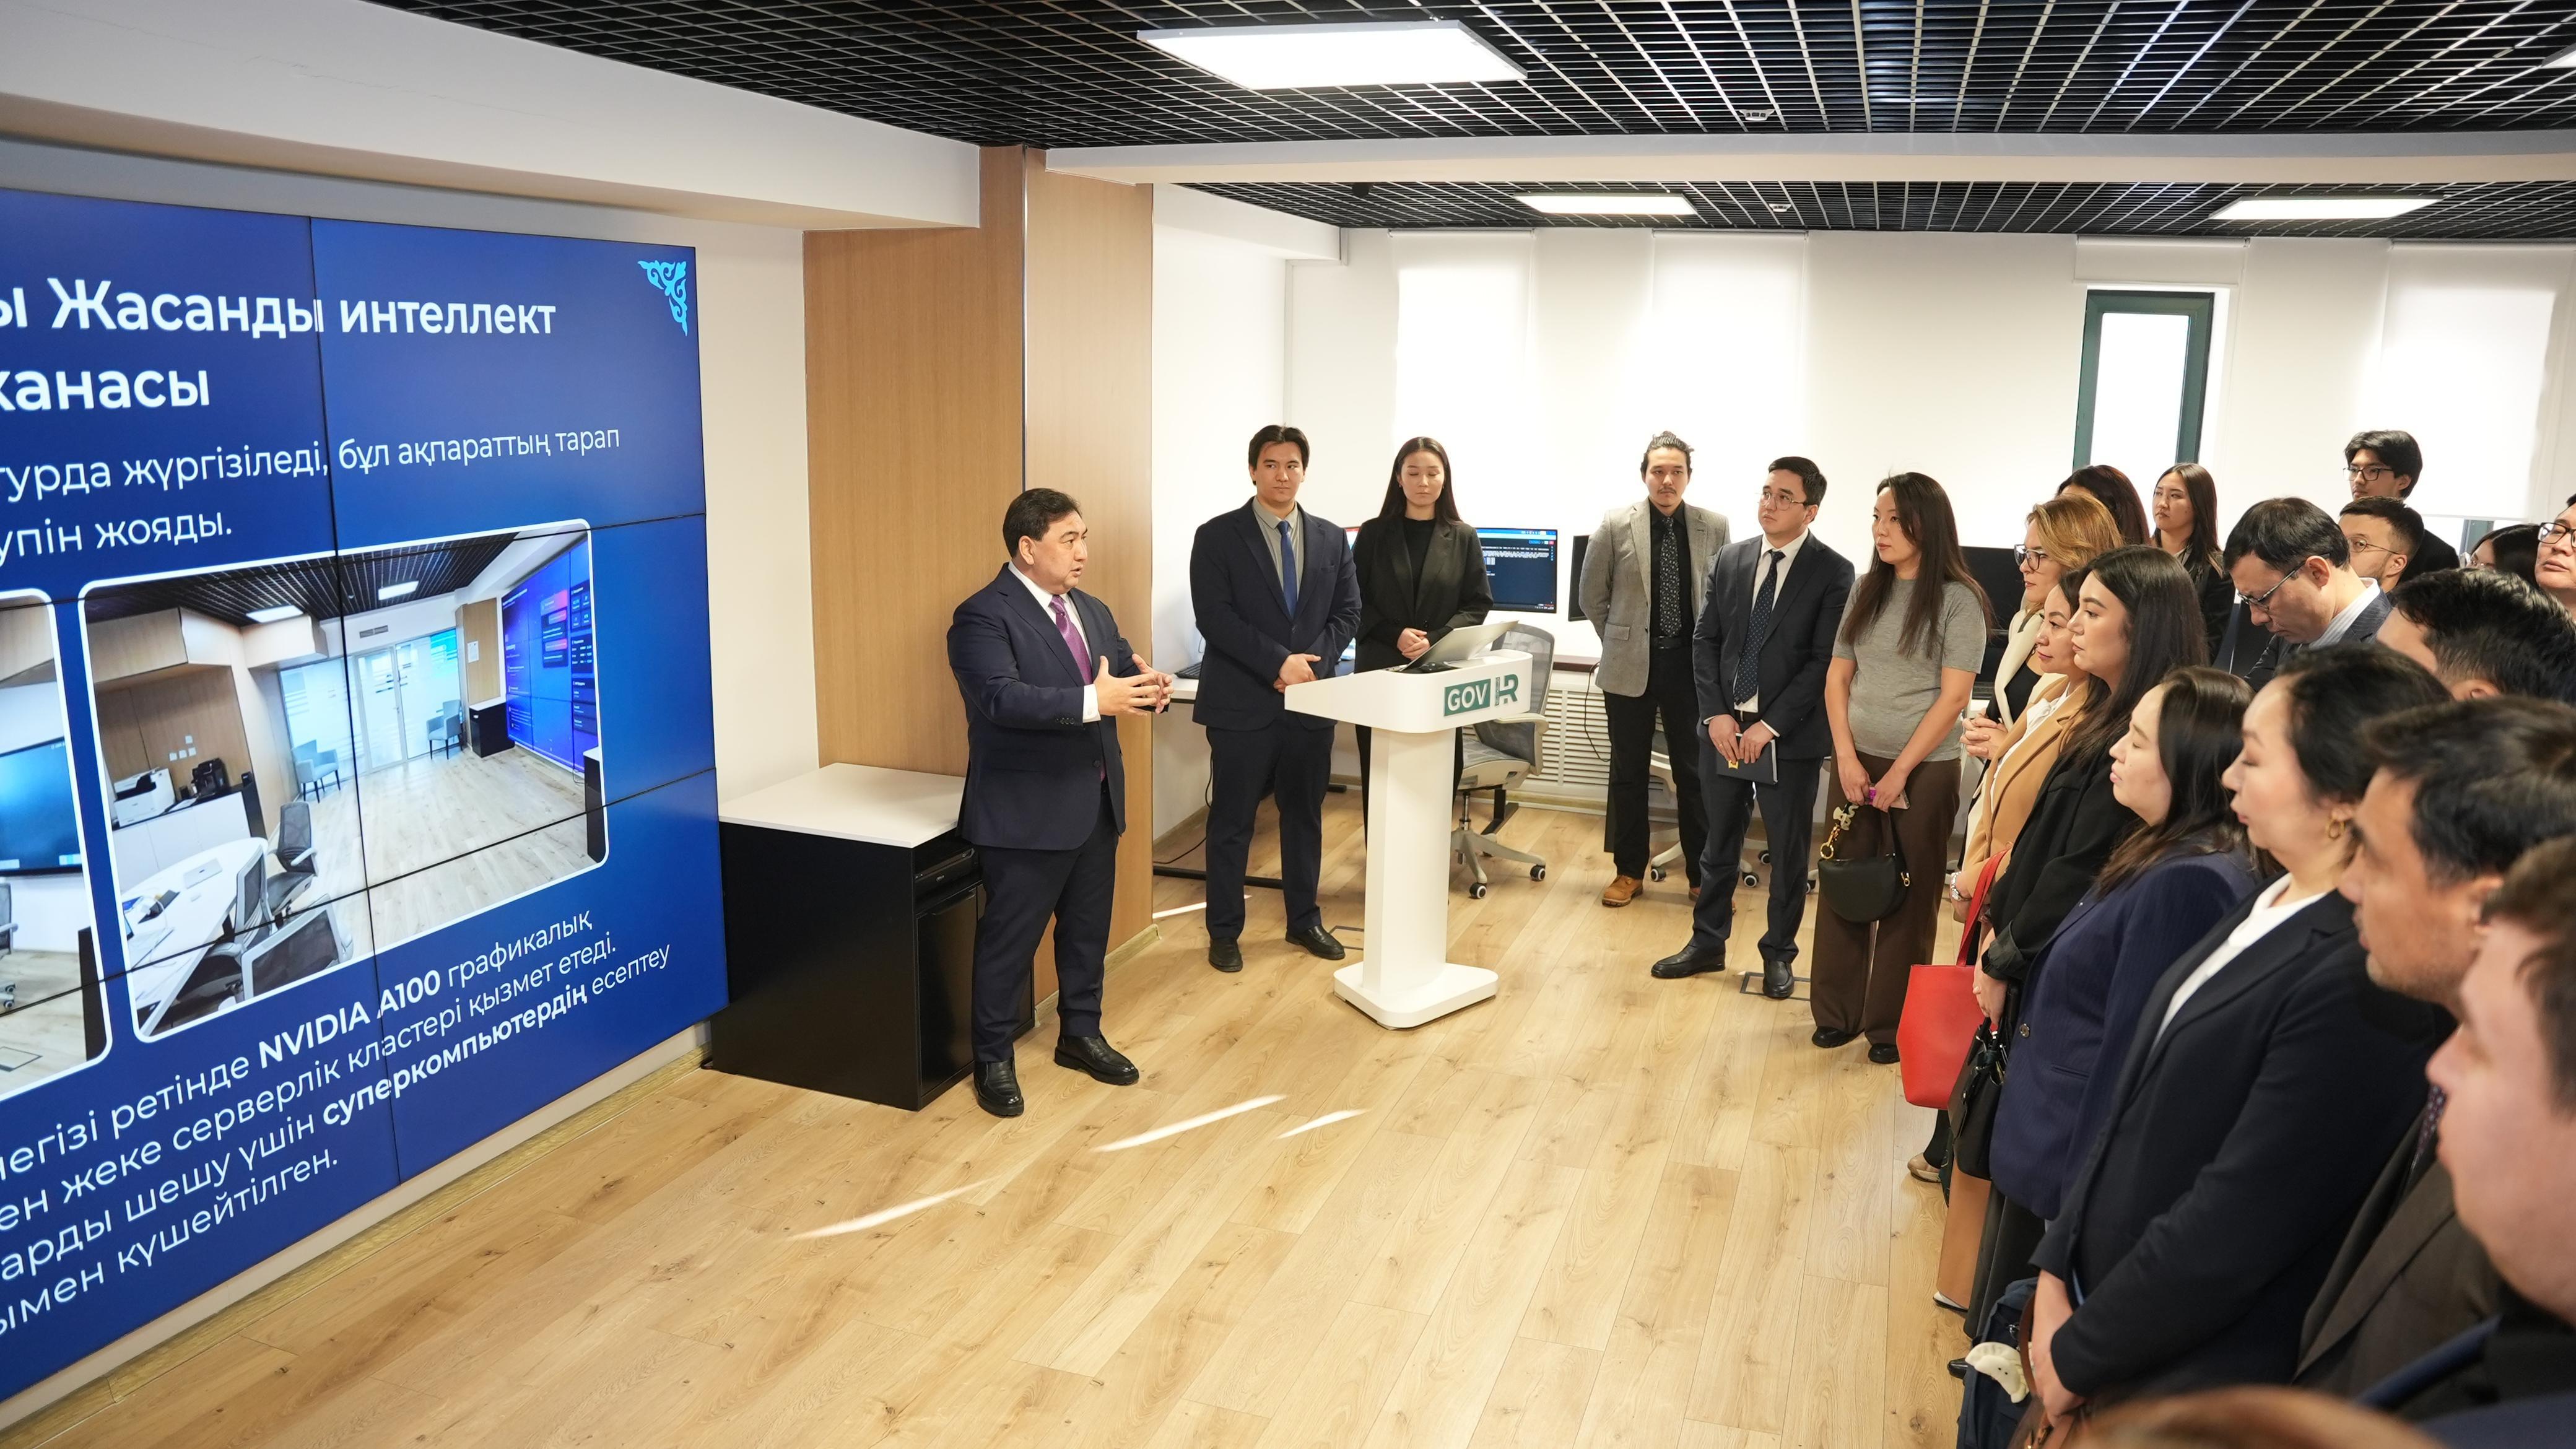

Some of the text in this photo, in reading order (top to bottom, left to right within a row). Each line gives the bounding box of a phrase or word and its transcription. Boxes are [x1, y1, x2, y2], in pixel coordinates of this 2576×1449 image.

[47, 277, 324, 339] Жасанды
[340, 300, 556, 334] интеллект
[123, 440, 328, 491] жүргізіледі,
[339, 438, 389, 474] бұл
[398, 433, 551, 466] ақпараттың
[554, 429, 620, 456] тарап
[95, 512, 232, 549] жояды.
[1447, 682, 1489, 711] GOV
[0, 910, 593, 1180] егізі ретінде NVIDIA A100 графикалық
[61, 1141, 162, 1204] жеке
[173, 1059, 341, 1151] серверлік
[348, 998, 461, 1073] кластері
[469, 962, 554, 1017] қызмет
[559, 931, 616, 975] етеді.
[1, 944, 670, 1280] арды шешу үшін суперкомпьютердің есептеу
[118, 1149, 337, 1273] күшейтілген.
